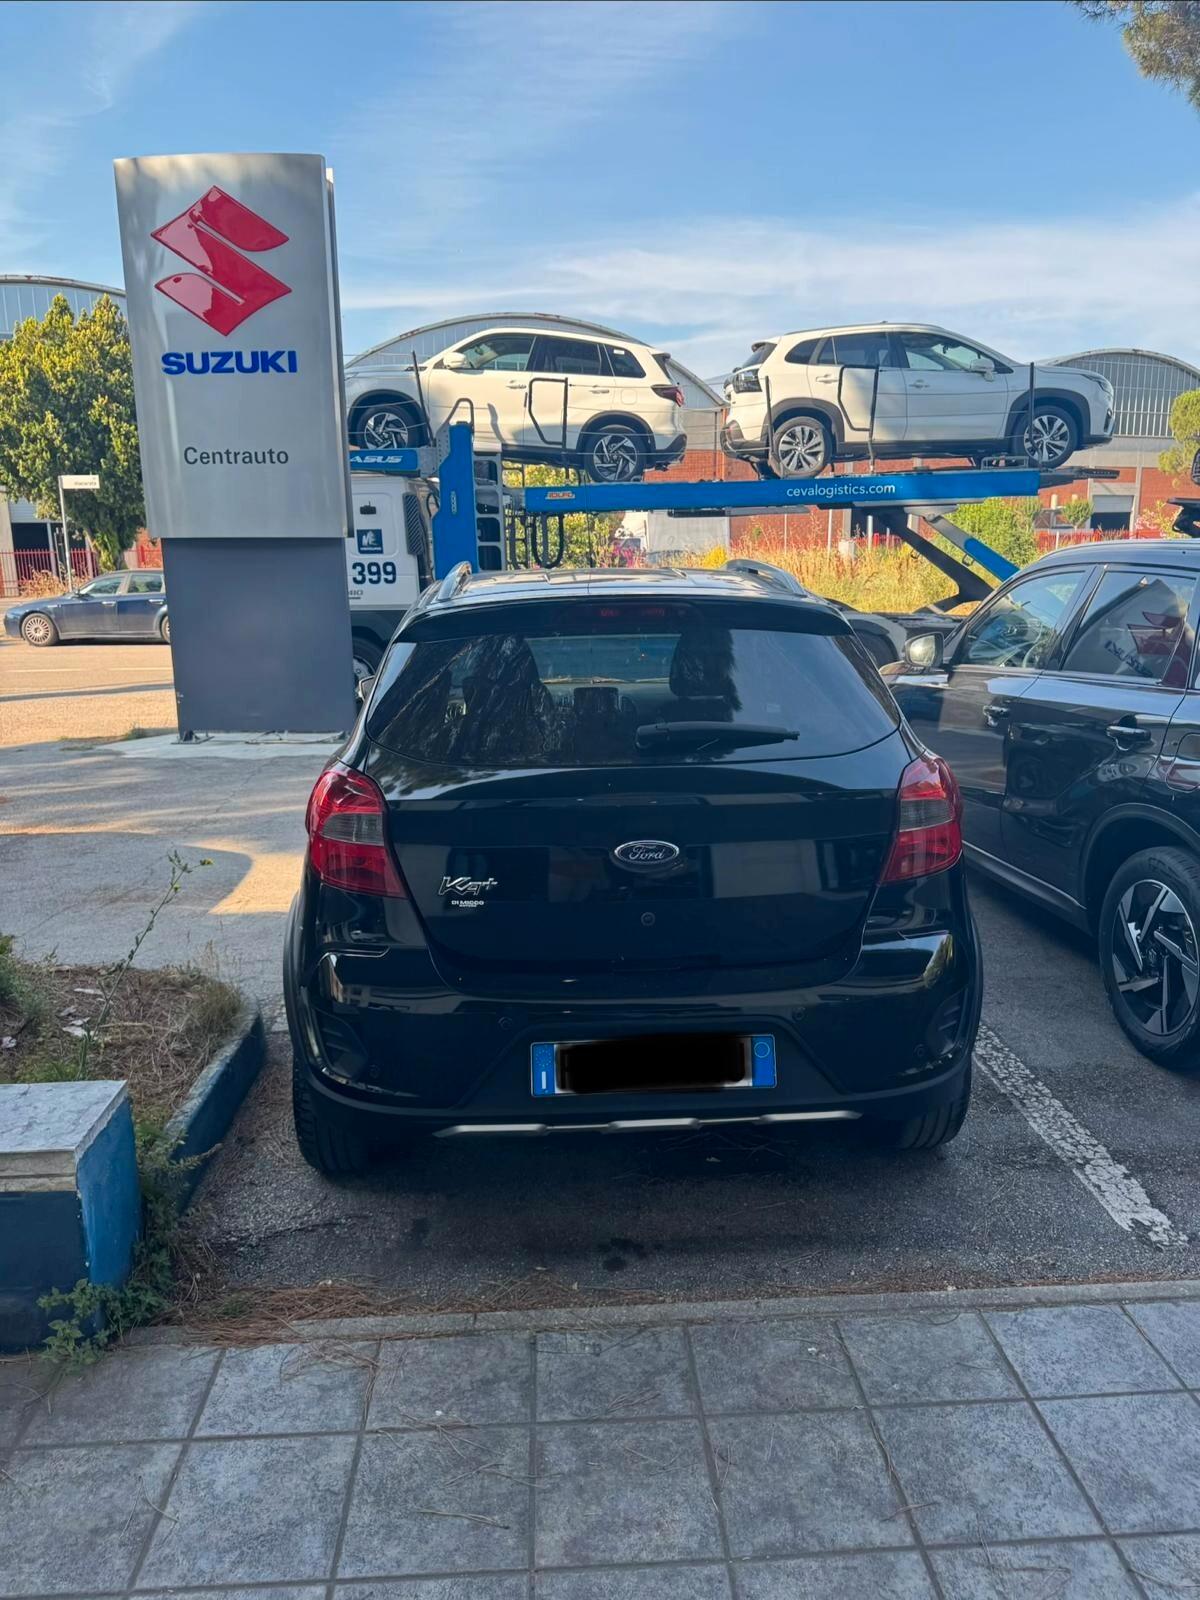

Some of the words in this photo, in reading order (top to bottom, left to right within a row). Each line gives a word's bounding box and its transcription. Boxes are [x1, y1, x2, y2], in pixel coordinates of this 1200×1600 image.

[161, 350, 298, 375] SUZUKI
[184, 446, 289, 465] Centrauto
[786, 483, 896, 499] cevalogistics.com
[352, 561, 397, 585] 399
[628, 844, 665, 860] Ford
